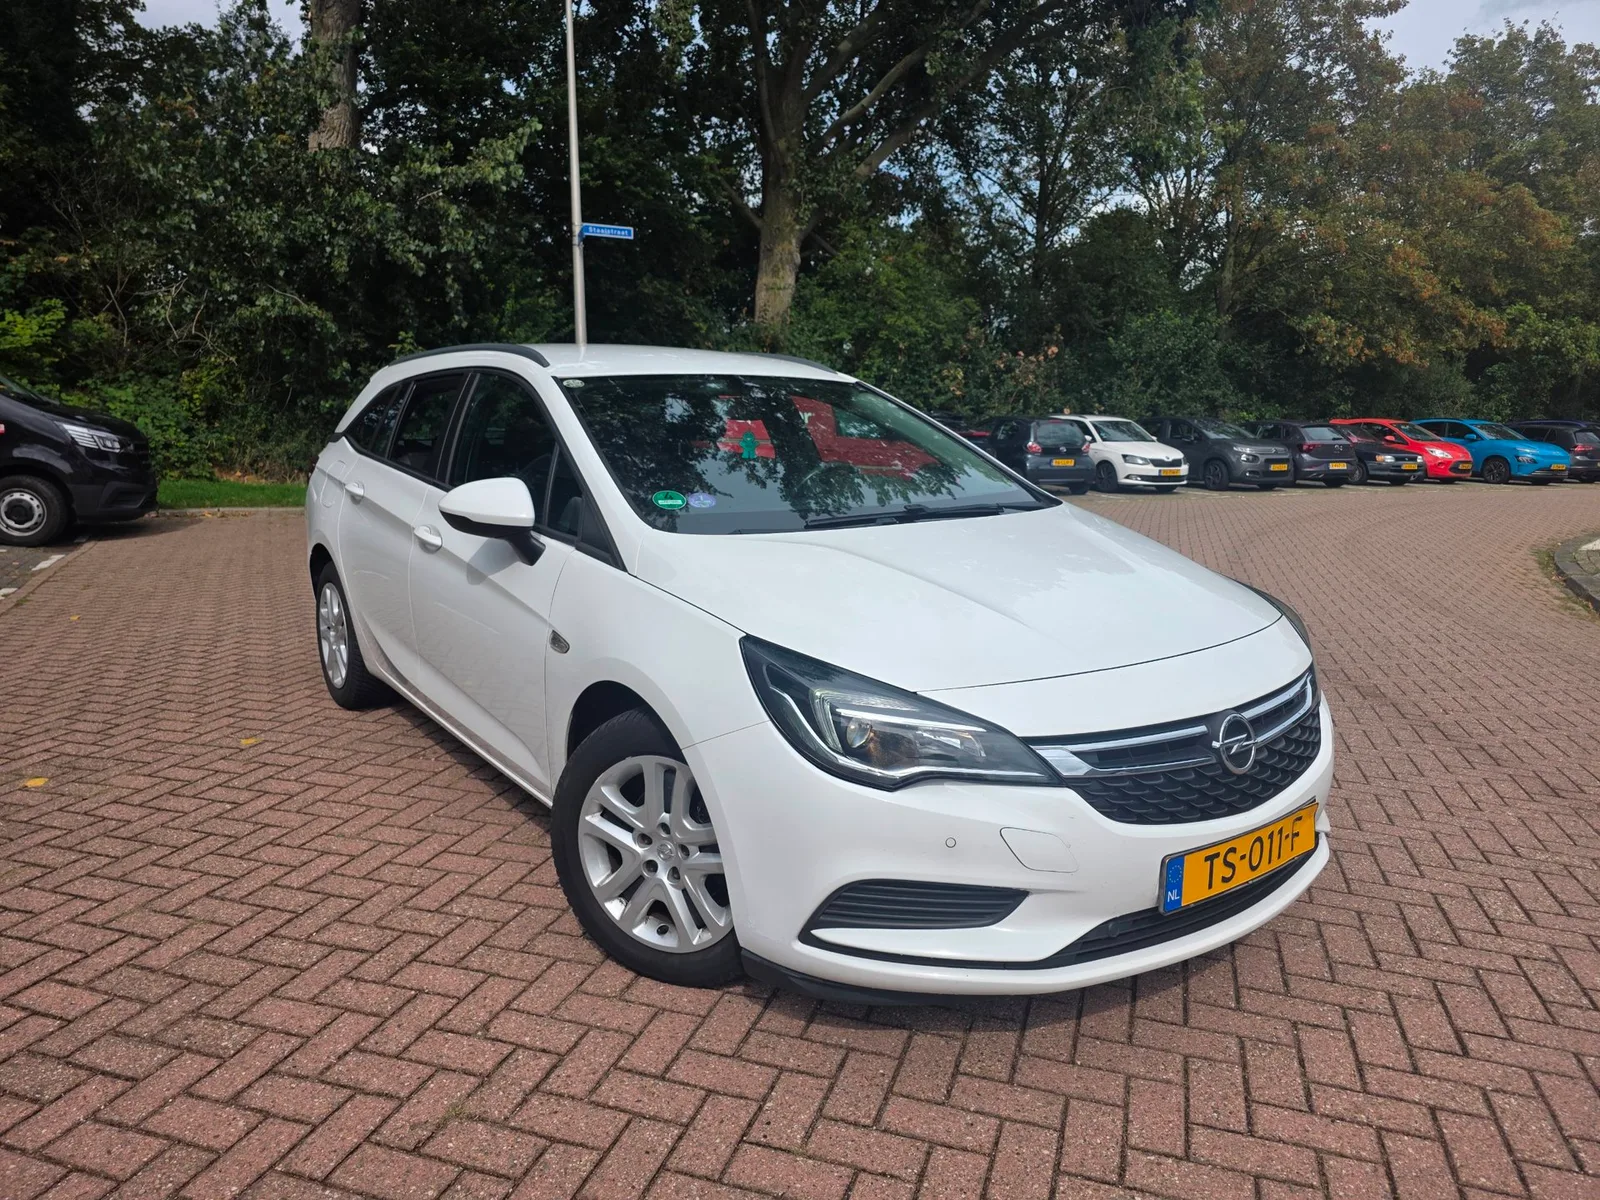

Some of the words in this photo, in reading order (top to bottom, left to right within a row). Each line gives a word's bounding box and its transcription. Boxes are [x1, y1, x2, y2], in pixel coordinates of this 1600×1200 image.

[588, 226, 629, 235] Staalstraat
[1204, 816, 1303, 890] TS-011-F
[1167, 888, 1180, 902] NL
